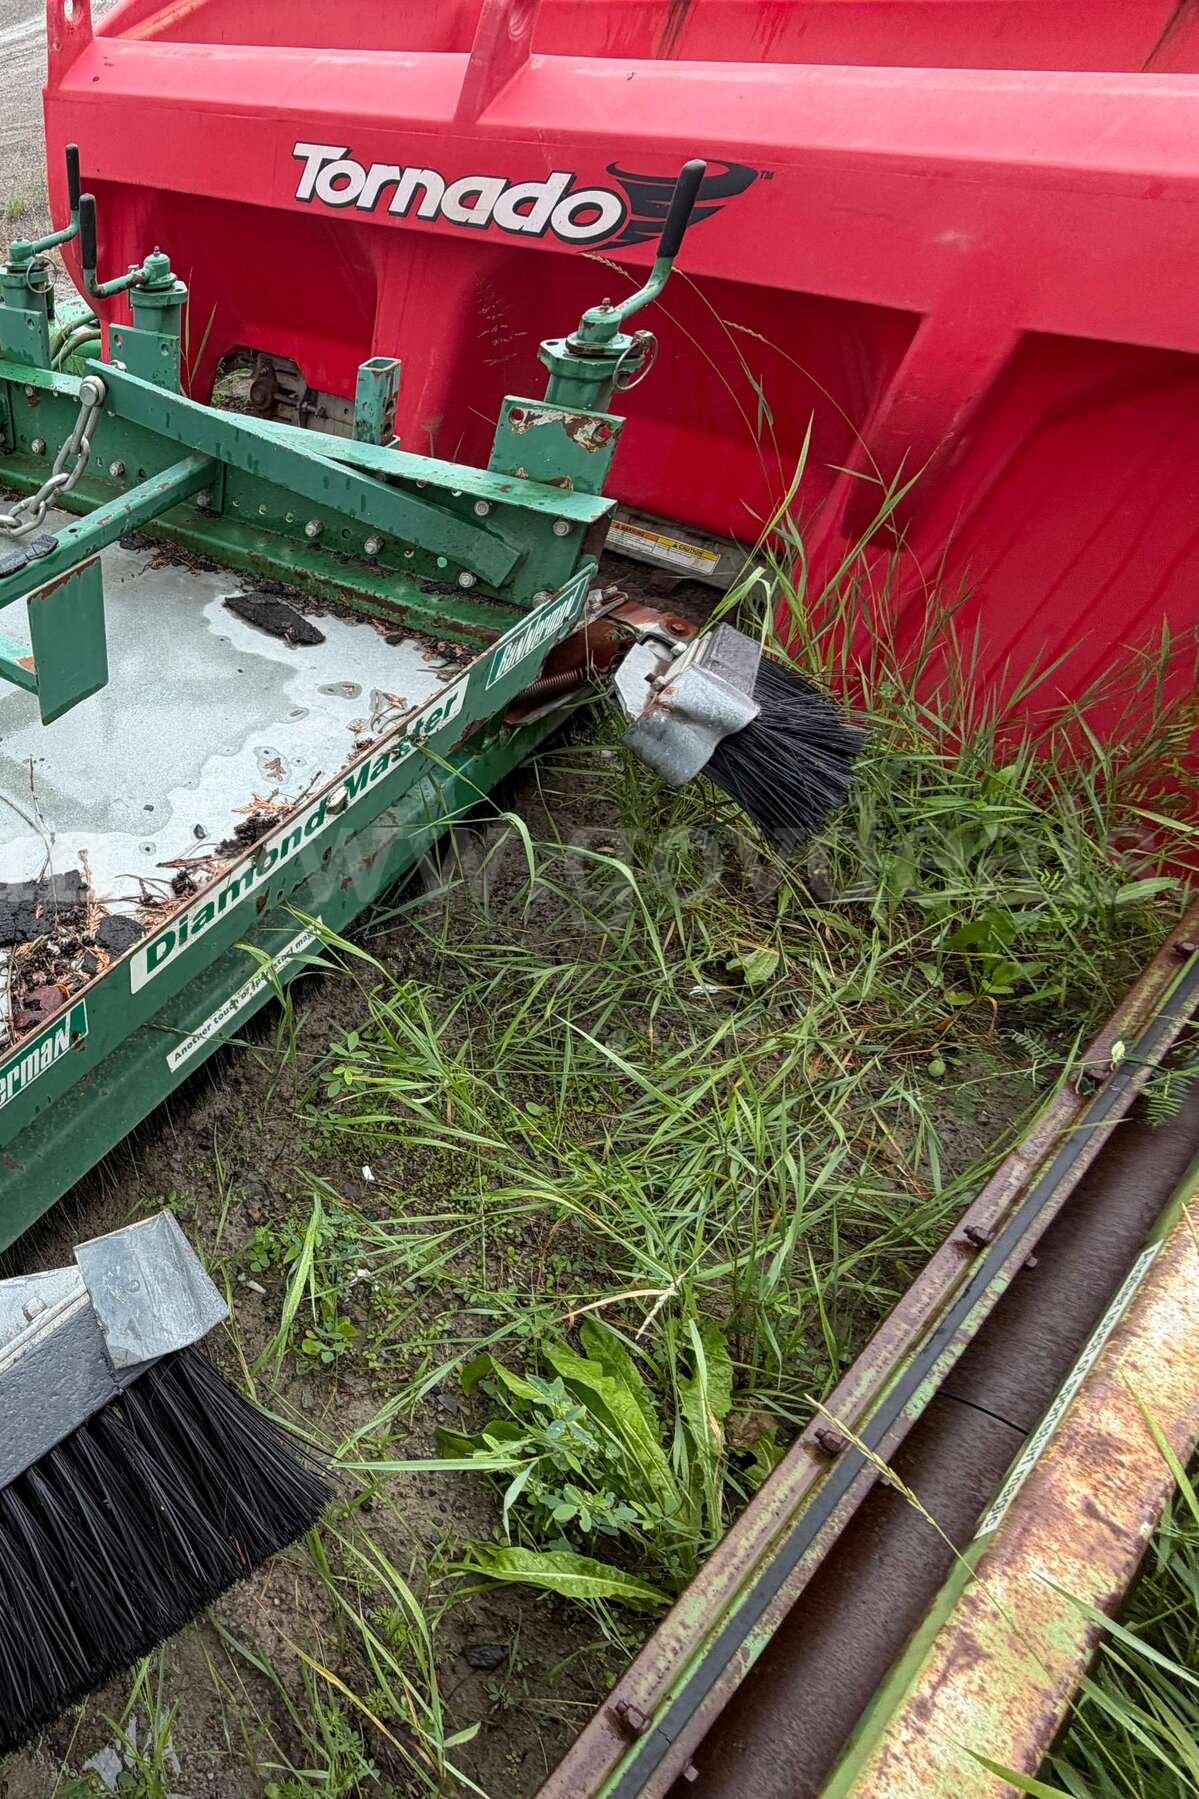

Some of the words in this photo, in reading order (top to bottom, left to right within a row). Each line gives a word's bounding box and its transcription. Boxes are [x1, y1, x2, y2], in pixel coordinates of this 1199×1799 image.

[293, 142, 627, 244] Tornado
[146, 799, 329, 977] Diamond
[344, 692, 460, 800] Master
